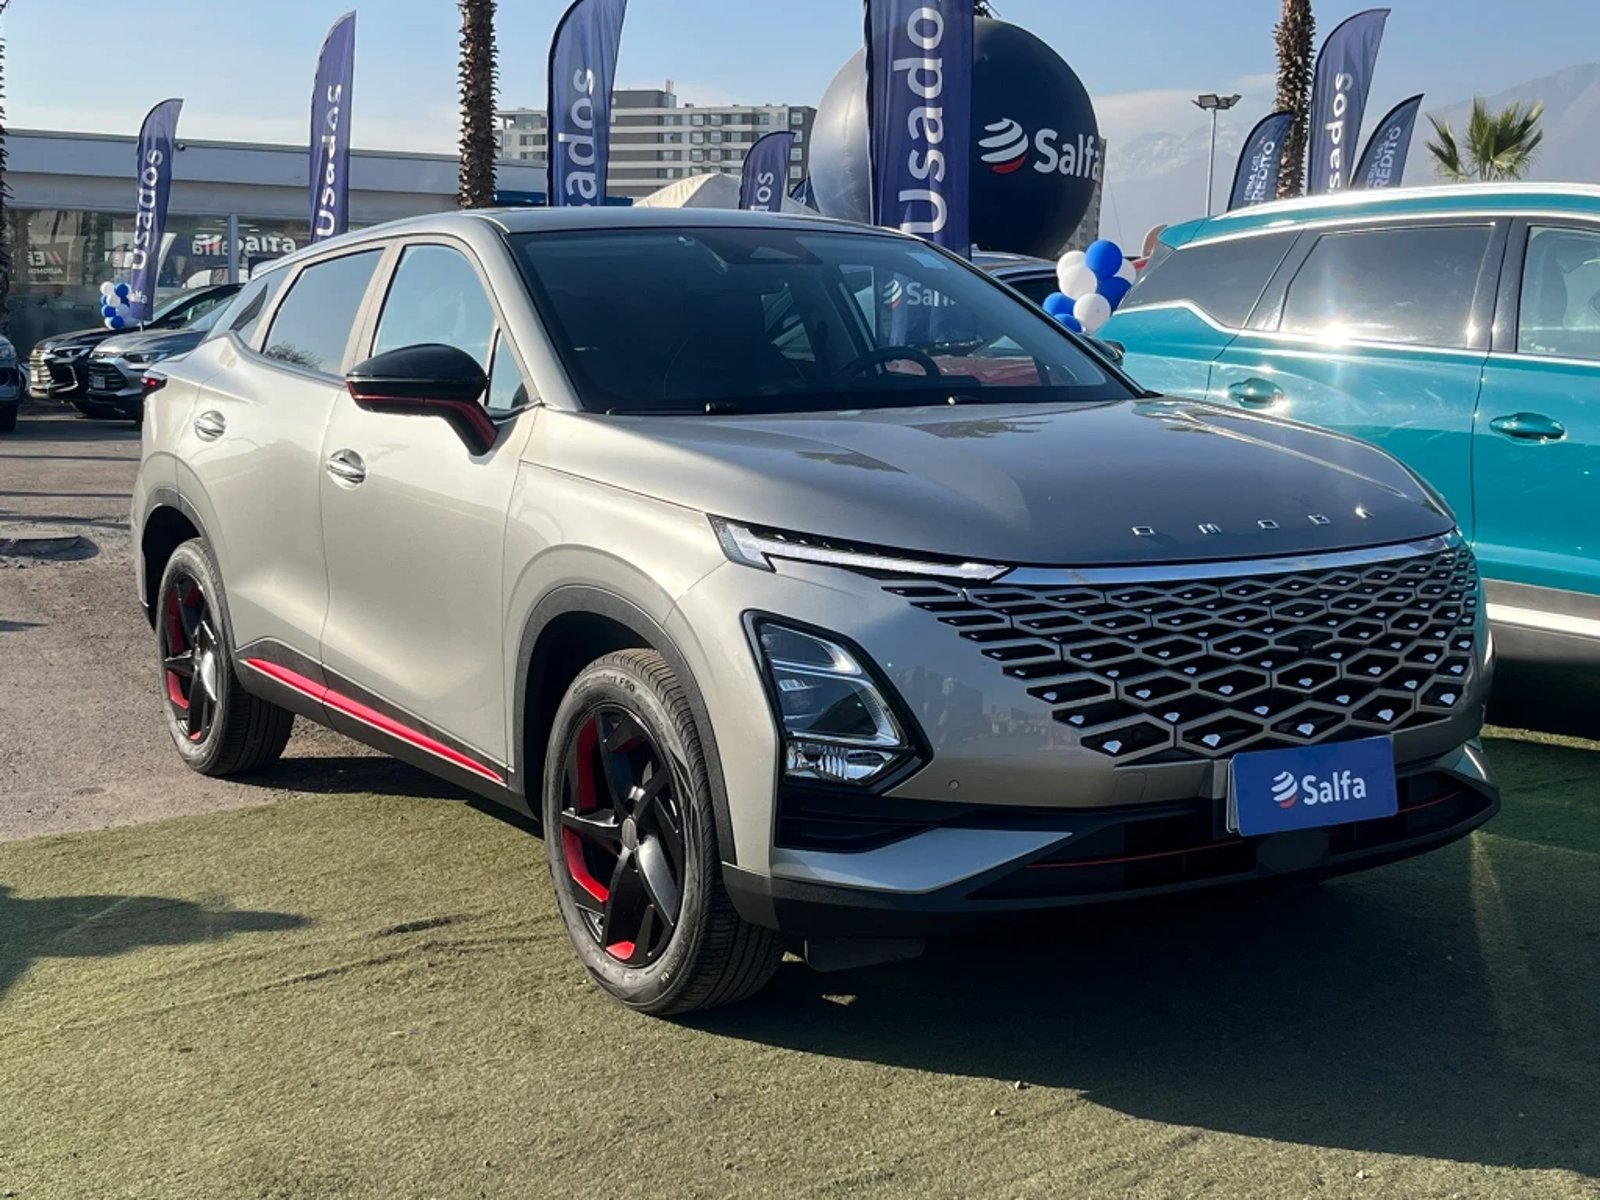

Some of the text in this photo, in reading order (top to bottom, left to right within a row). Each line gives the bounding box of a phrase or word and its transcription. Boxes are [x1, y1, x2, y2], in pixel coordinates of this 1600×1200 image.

[316, 84, 342, 237] Usados
[557, 68, 597, 206] ados
[893, 0, 948, 234] Usado
[1033, 128, 1102, 182] Salfa
[1250, 141, 1275, 204] REDITO
[1325, 73, 1354, 192] sados
[1373, 126, 1401, 188] REDITO
[131, 149, 163, 270] Usados
[1301, 770, 1367, 805] Salfa
